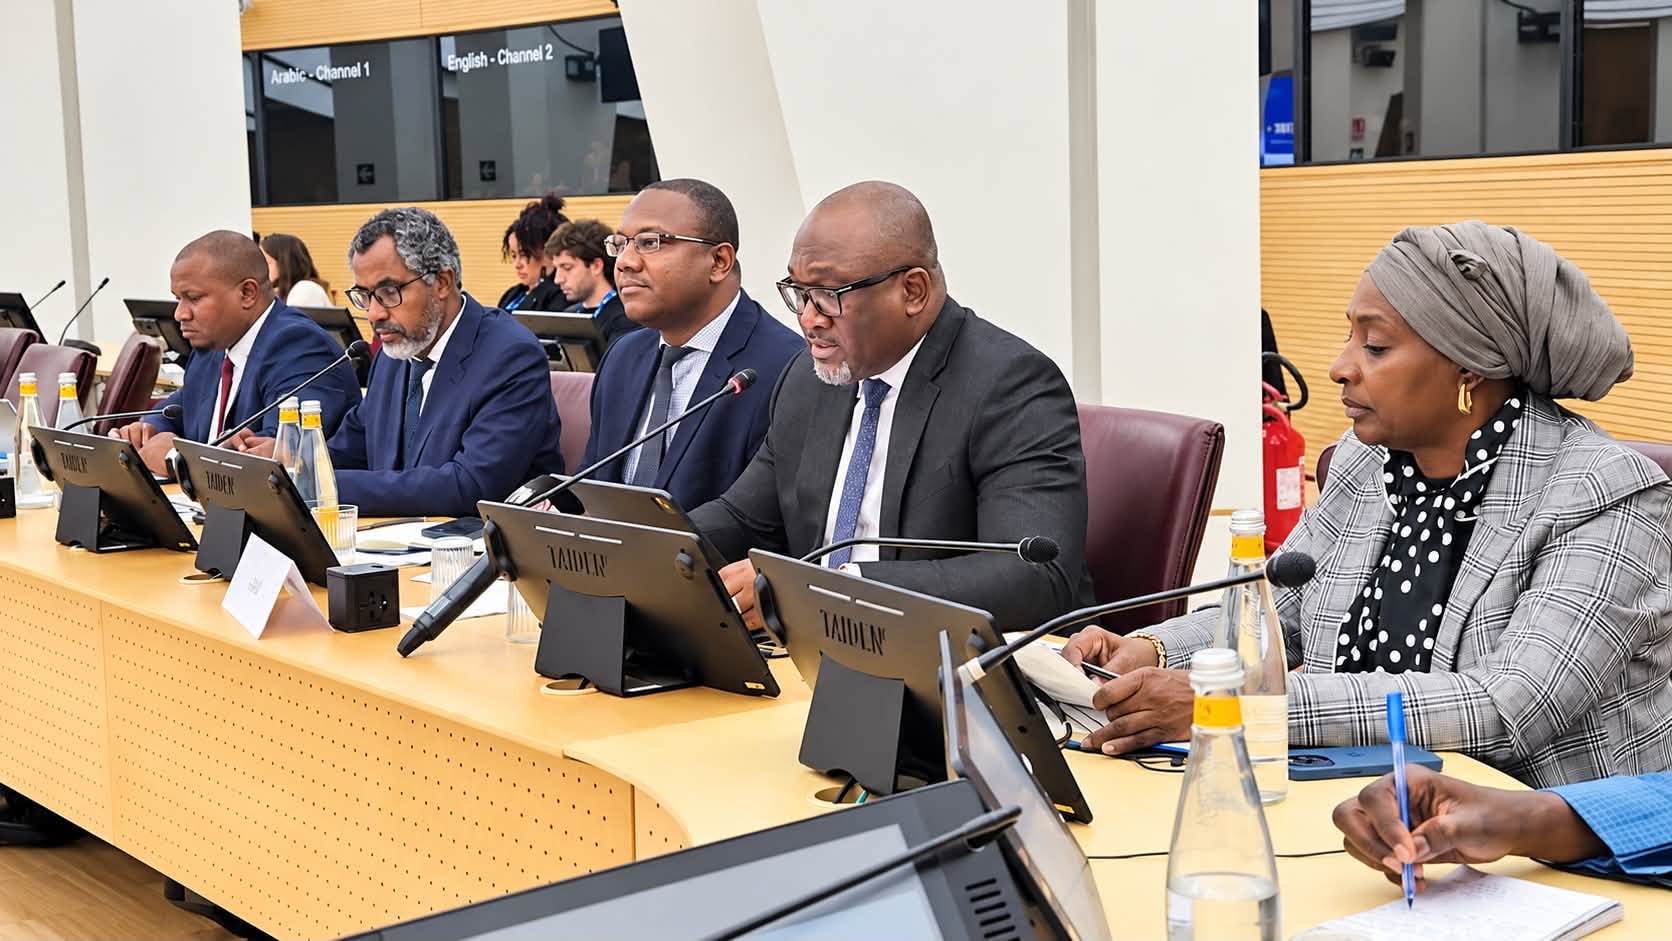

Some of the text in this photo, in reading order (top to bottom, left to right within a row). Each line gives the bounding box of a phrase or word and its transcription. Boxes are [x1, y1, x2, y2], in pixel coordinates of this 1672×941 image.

[271, 67, 307, 85] Arabic
[315, 62, 362, 82] Channel
[364, 61, 371, 78] 1
[447, 53, 488, 73] English
[497, 46, 543, 66] Channel
[545, 44, 553, 61] 2
[206, 471, 235, 496] TAIDEN
[547, 545, 608, 577] TAIDEN
[819, 610, 886, 656] TAIDEN
